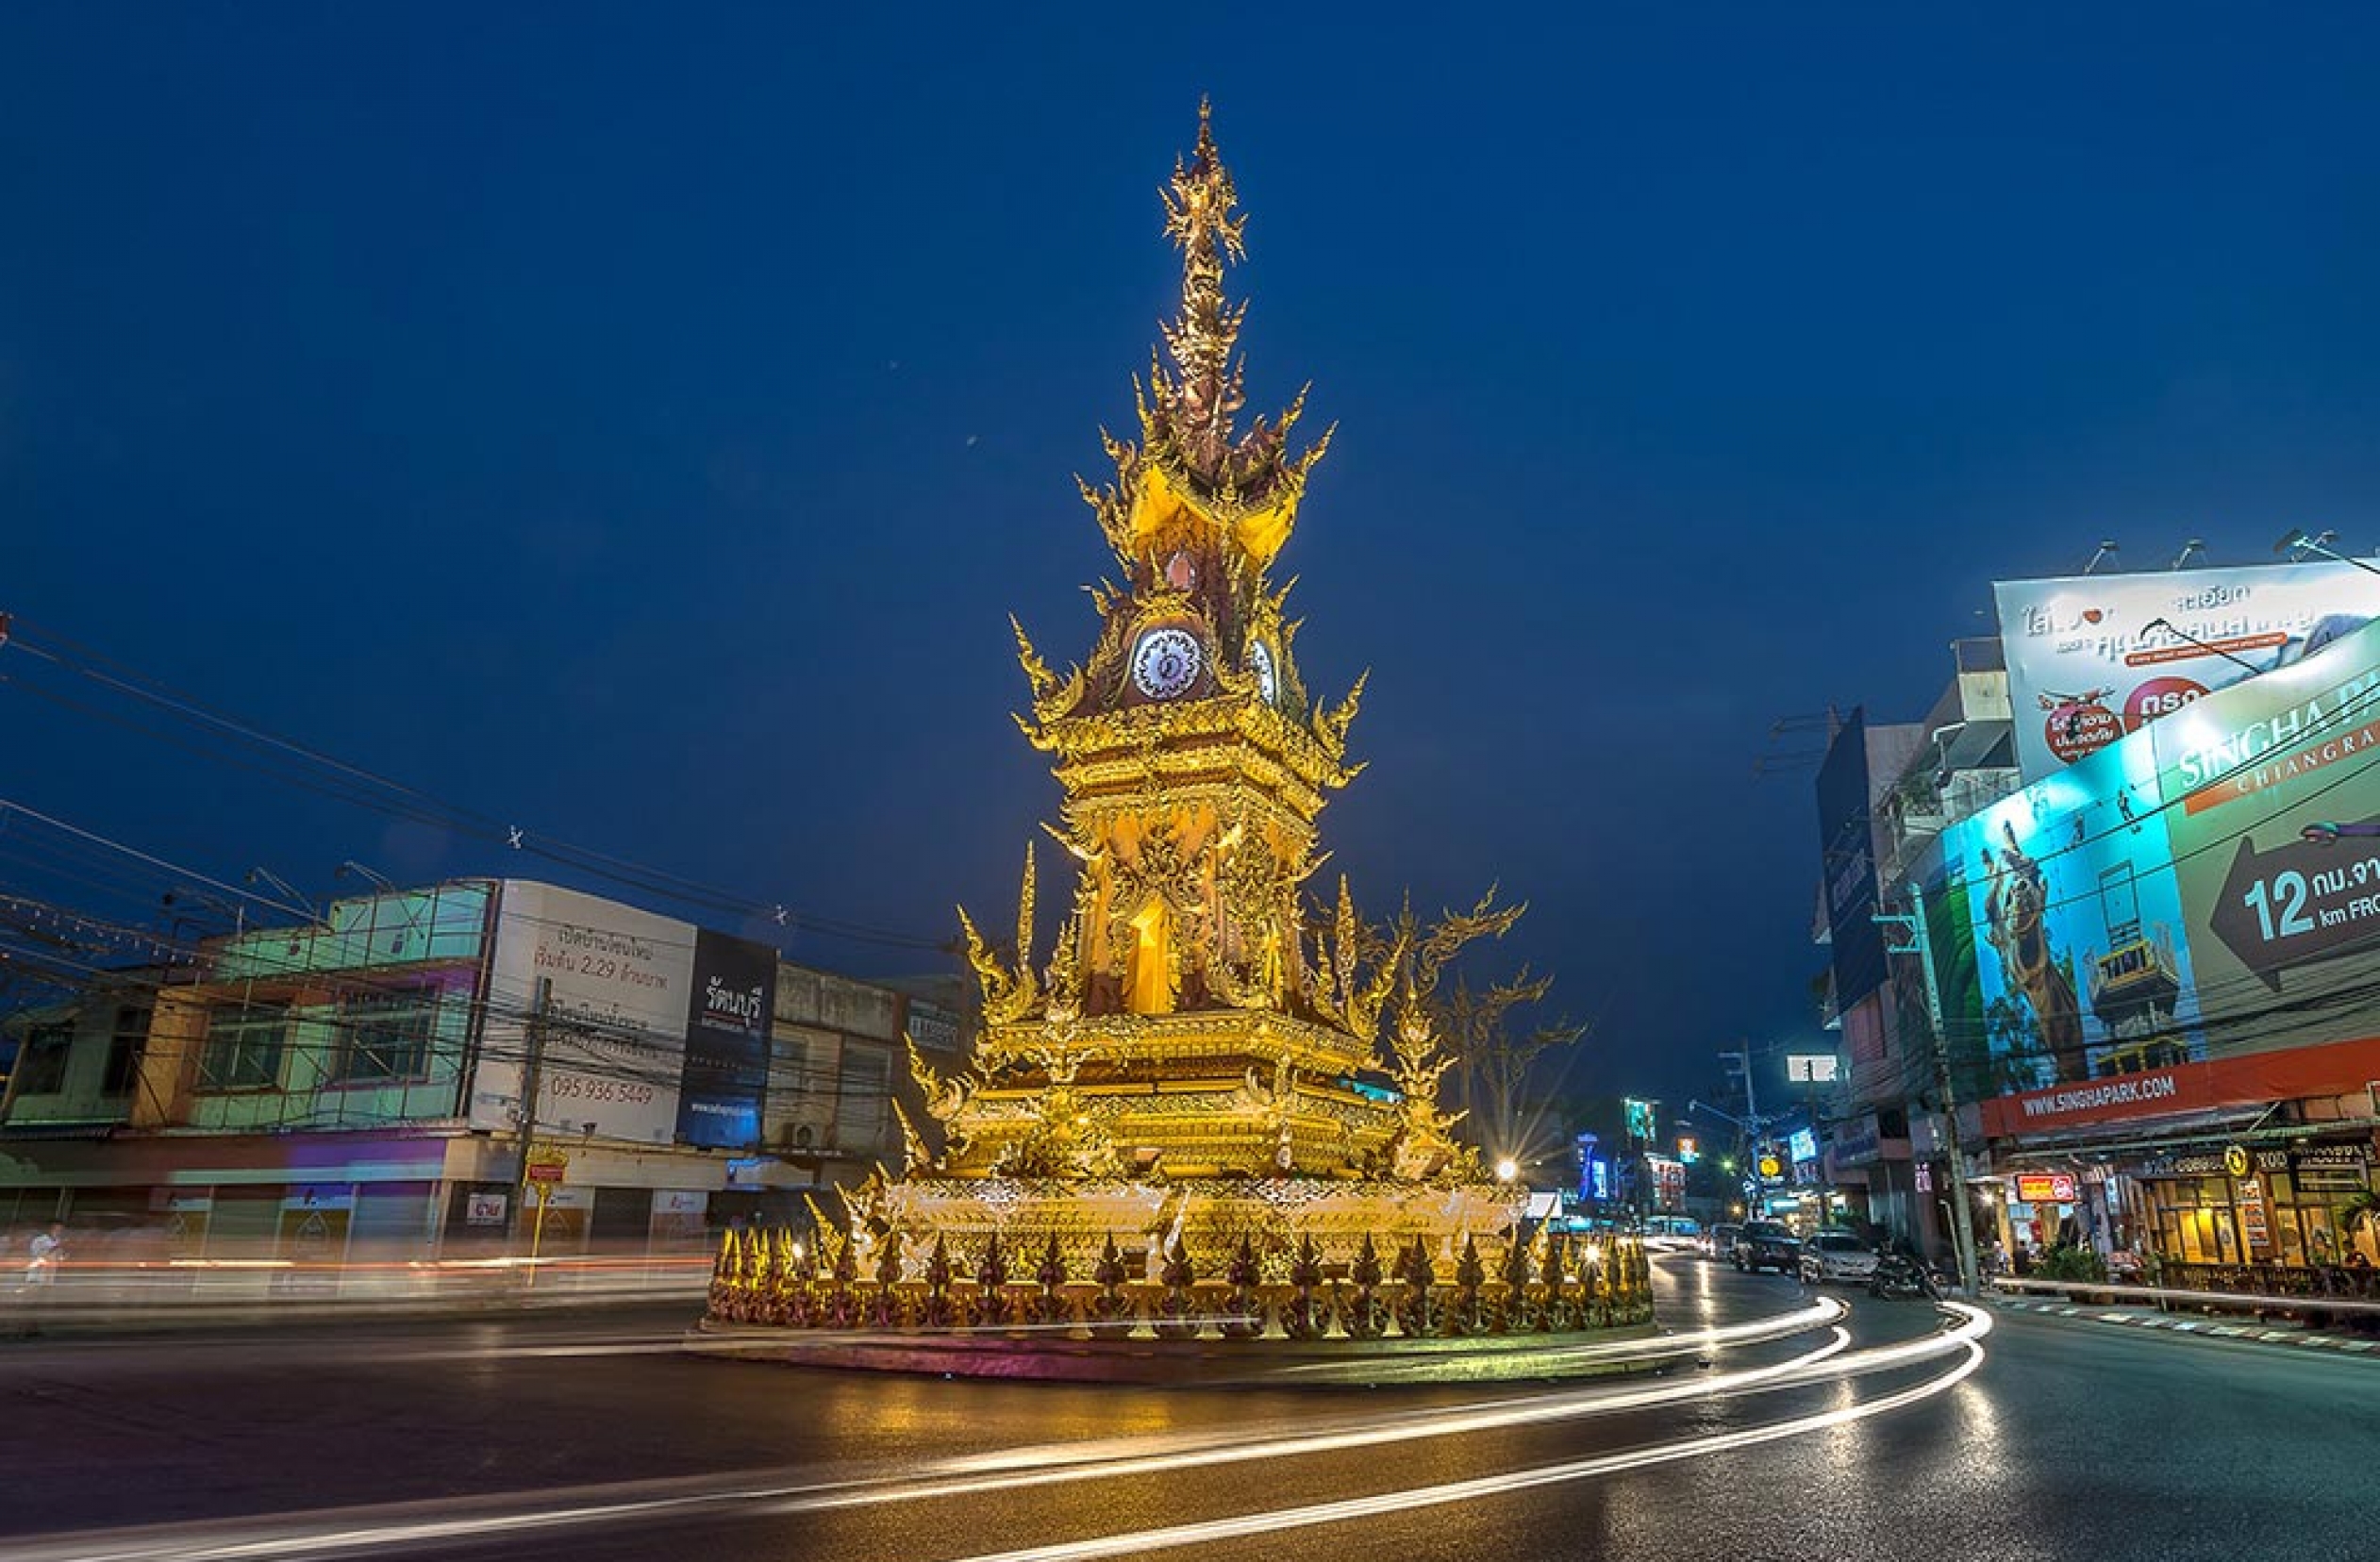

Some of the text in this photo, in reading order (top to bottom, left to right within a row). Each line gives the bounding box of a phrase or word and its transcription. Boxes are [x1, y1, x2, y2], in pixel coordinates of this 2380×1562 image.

[2179, 701, 2331, 788] SINGHA
[2244, 871, 2315, 941] 12
[2320, 908, 2347, 927] km
[581, 955, 614, 977] 2.29
[552, 1076, 579, 1097] 095
[2022, 1076, 2175, 1116] WWW.SINGHAPARK.COM
